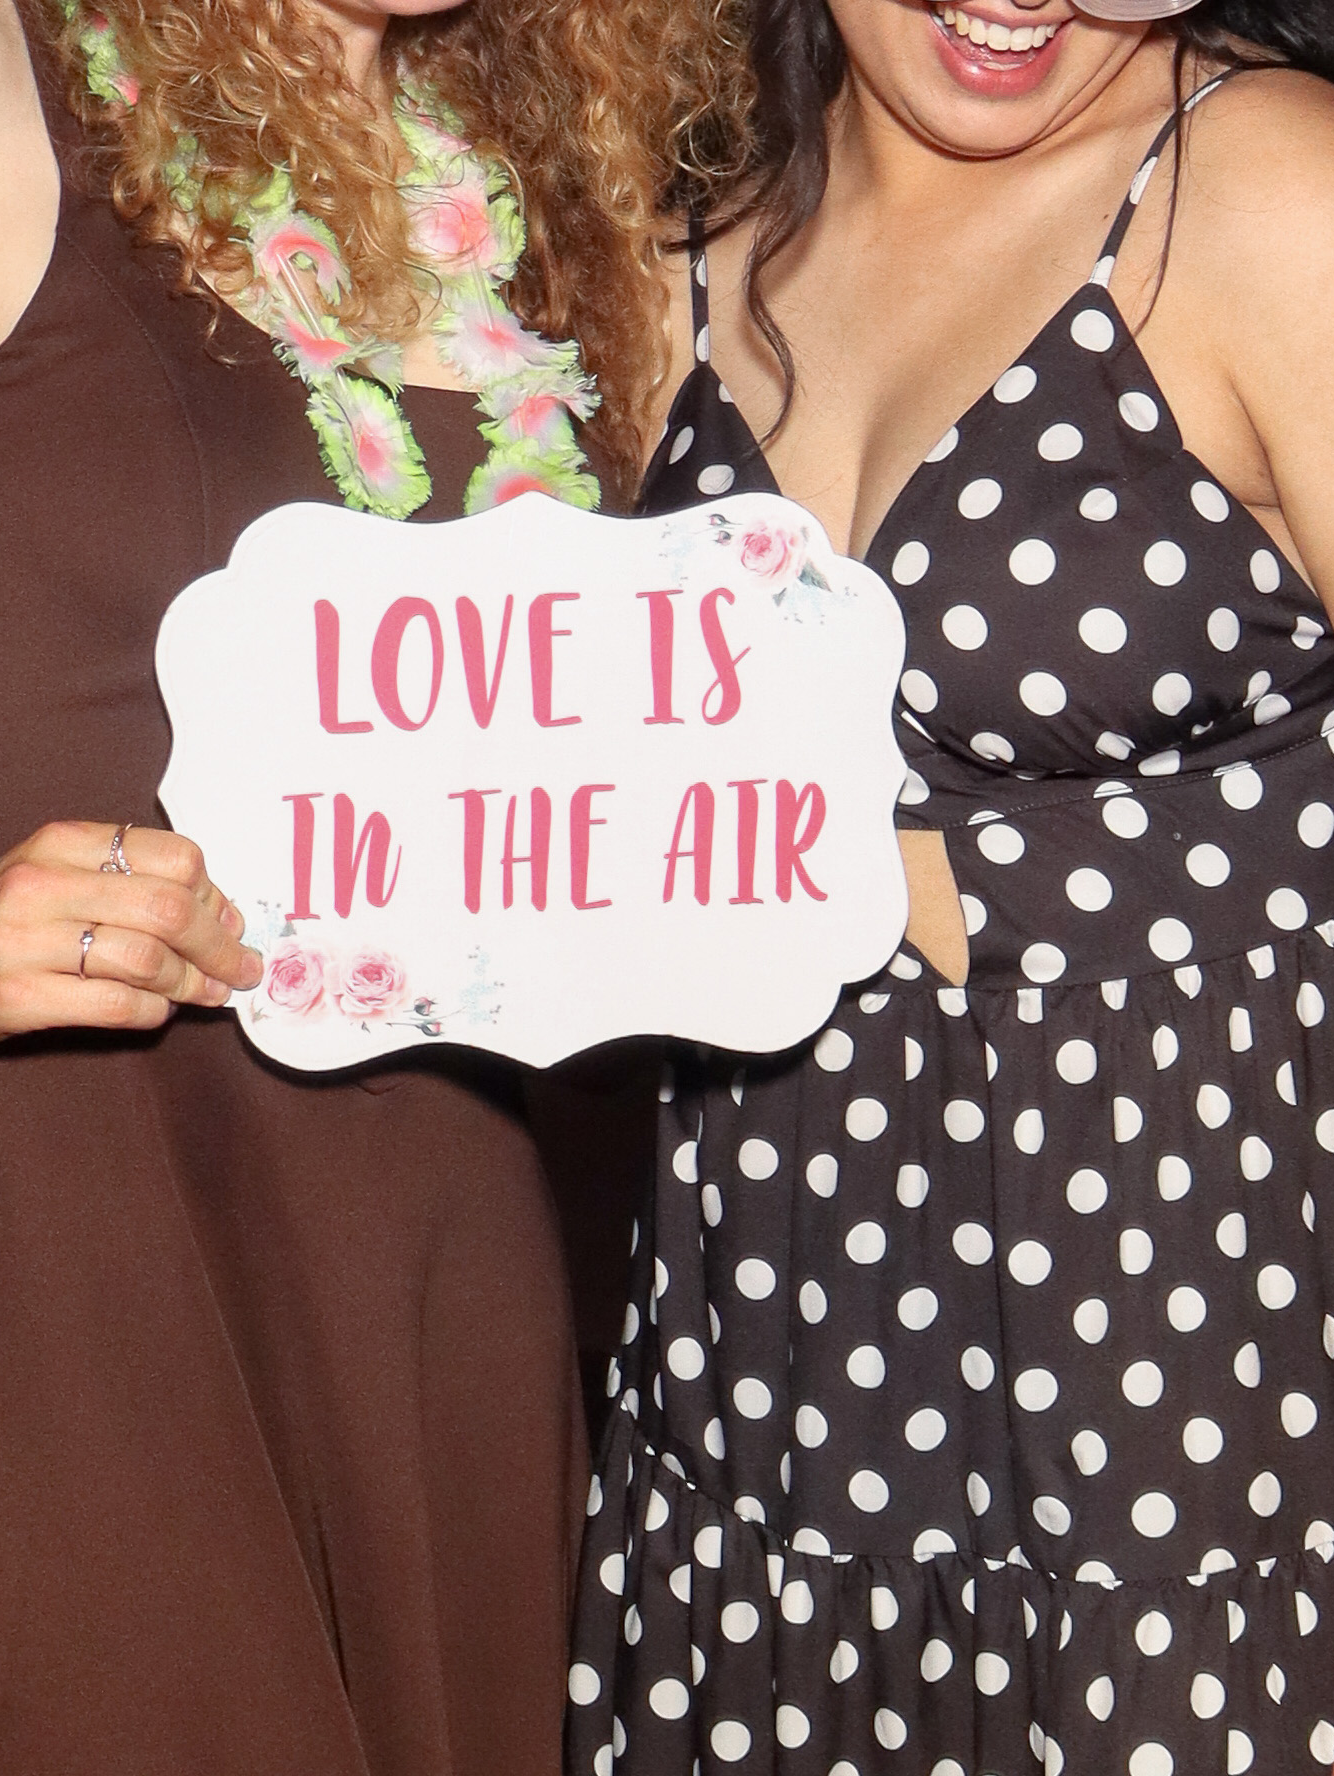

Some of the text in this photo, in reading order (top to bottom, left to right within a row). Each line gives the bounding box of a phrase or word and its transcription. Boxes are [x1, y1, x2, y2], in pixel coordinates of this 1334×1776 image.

[313, 587, 751, 734] LOVE IS
[448, 783, 617, 915] THE
[662, 778, 829, 907] AIR
